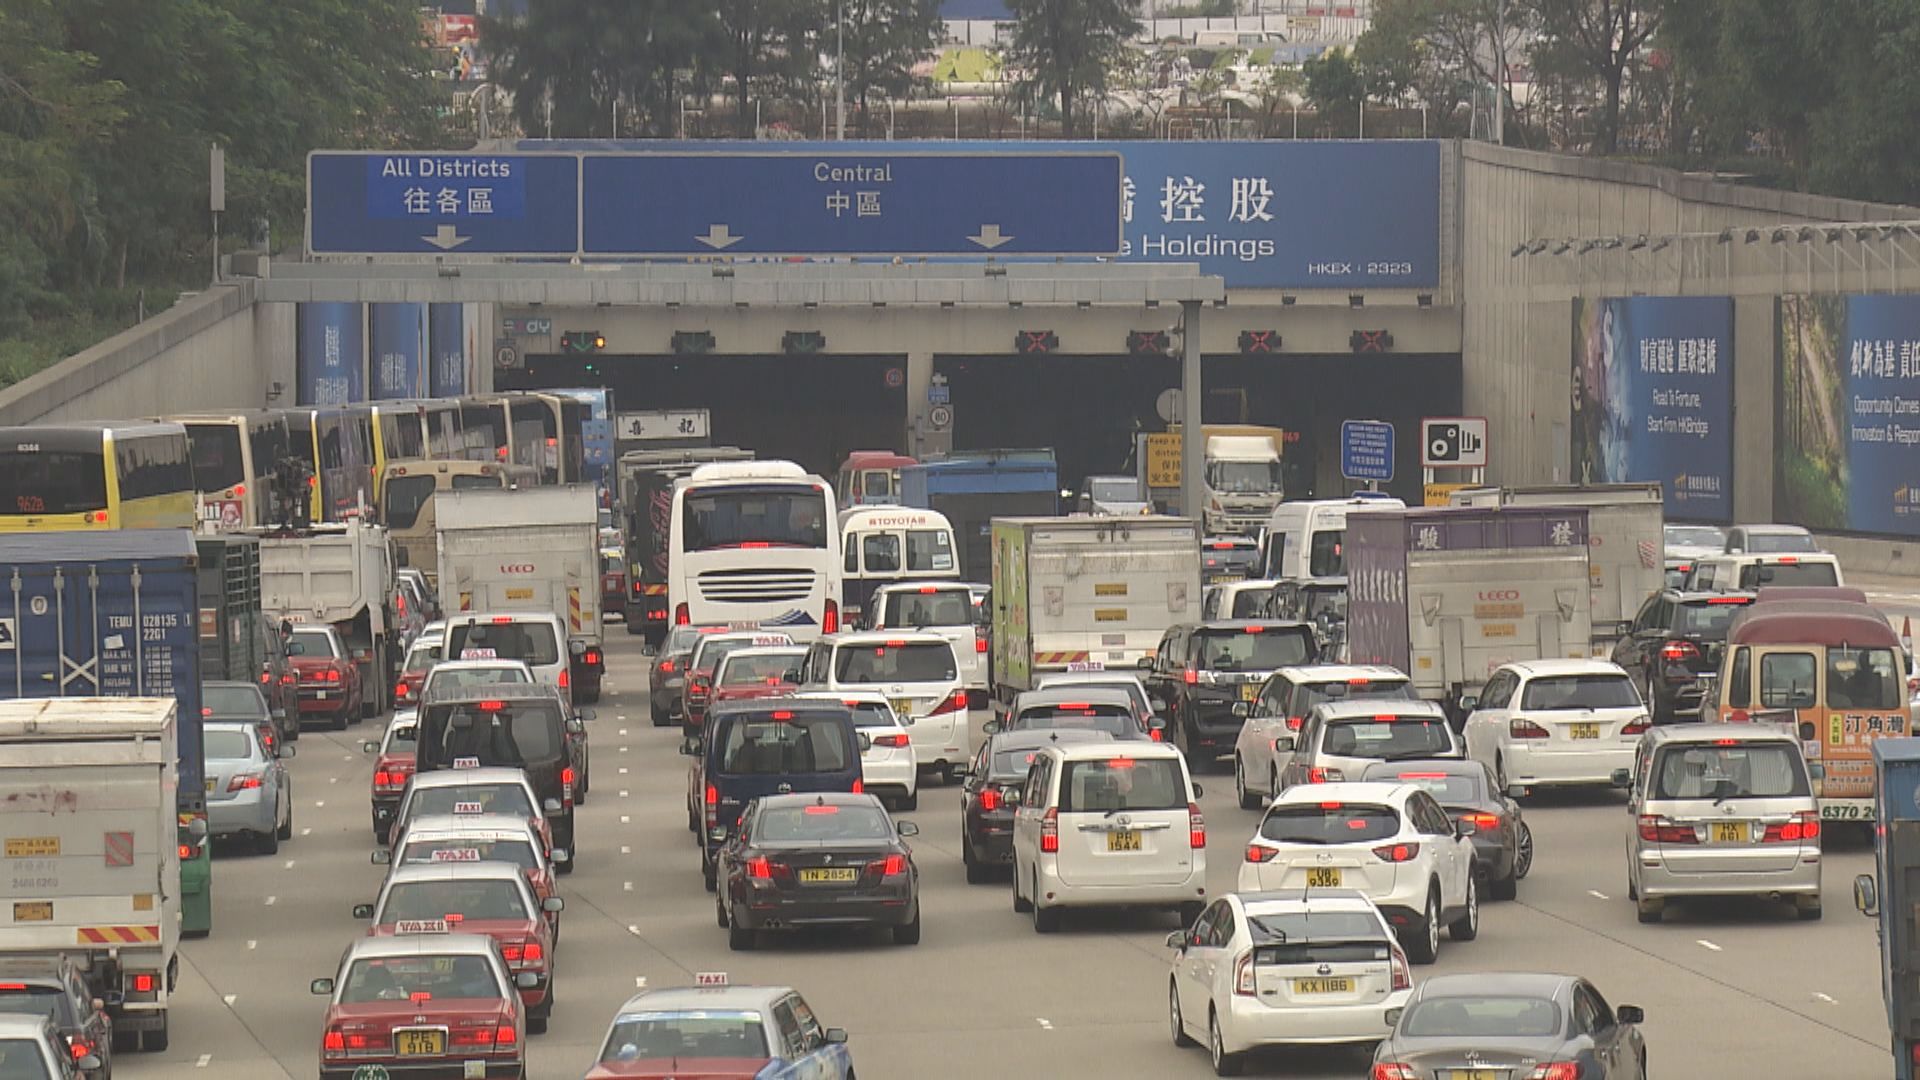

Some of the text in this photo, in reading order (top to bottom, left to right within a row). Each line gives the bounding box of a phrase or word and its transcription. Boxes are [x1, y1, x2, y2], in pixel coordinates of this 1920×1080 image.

[382, 158, 510, 178] All Districts
[814, 162, 892, 181] Central
[404, 187, 494, 214] 往各區
[826, 190, 881, 217] 中區
[1142, 234, 1275, 262] Holdings
[1308, 263, 1352, 275] HKEX
[1367, 263, 1412, 275] 2323
[1653, 388, 1668, 406] Road
[1854, 395, 1920, 418] Opportunity Comes
[1647, 414, 1663, 432] Start
[1426, 489, 1449, 498] Keep
[109, 615, 133, 628] TEMU
[755, 636, 784, 645] TAXI
[456, 759, 478, 768] TAXI
[457, 803, 480, 812] TAXI
[1822, 806, 1859, 818] 6370
[435, 850, 476, 860] TAXI
[399, 922, 444, 931] TAXI
[698, 975, 725, 984] TAXI
[1301, 983, 1318, 993] KX
[410, 1032, 431, 1042] PE
